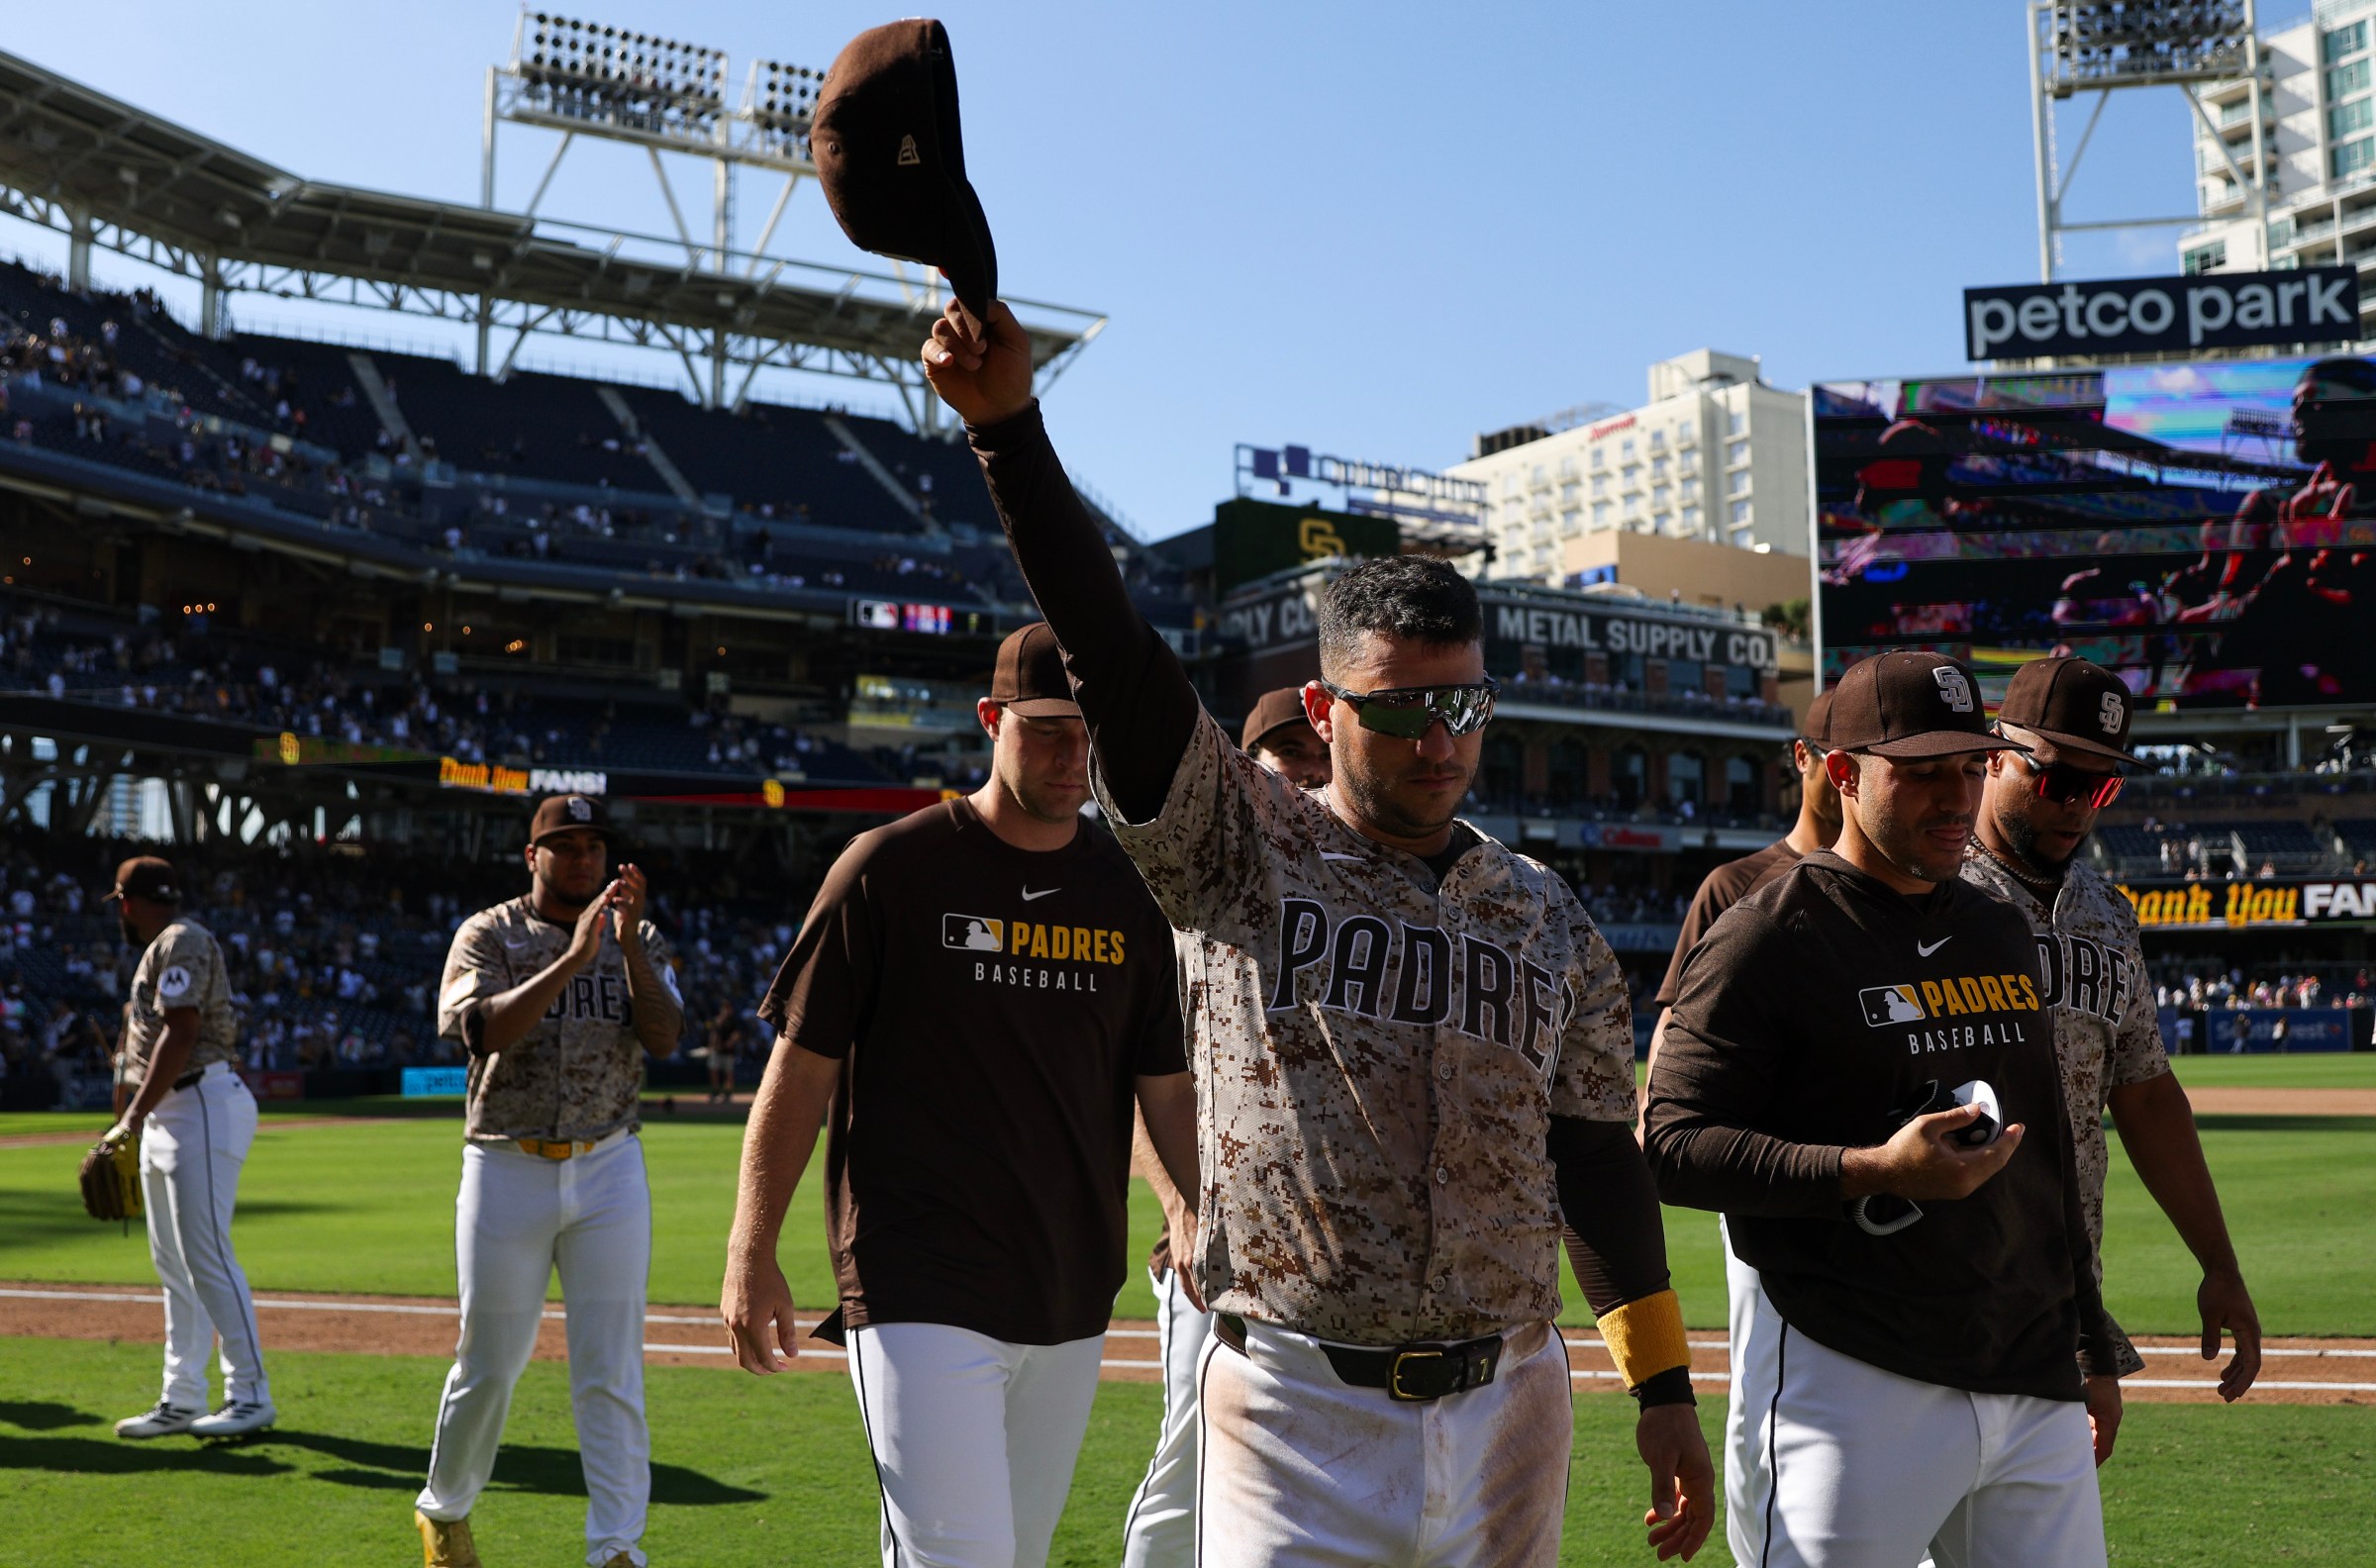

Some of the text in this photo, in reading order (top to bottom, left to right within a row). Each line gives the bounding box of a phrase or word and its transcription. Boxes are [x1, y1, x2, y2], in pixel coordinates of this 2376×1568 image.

[1971, 273, 2354, 357] petco park
[1497, 605, 1598, 651] METAL
[1605, 619, 1717, 662] SUPPLY
[530, 768, 607, 795] FANS!
[2227, 881, 2299, 928] You
[1011, 921, 1126, 966] PADRES
[974, 962, 1097, 992] BASEBALL
[1921, 974, 2039, 1019] PADRES
[1908, 1022, 2026, 1055] BASEBALL
